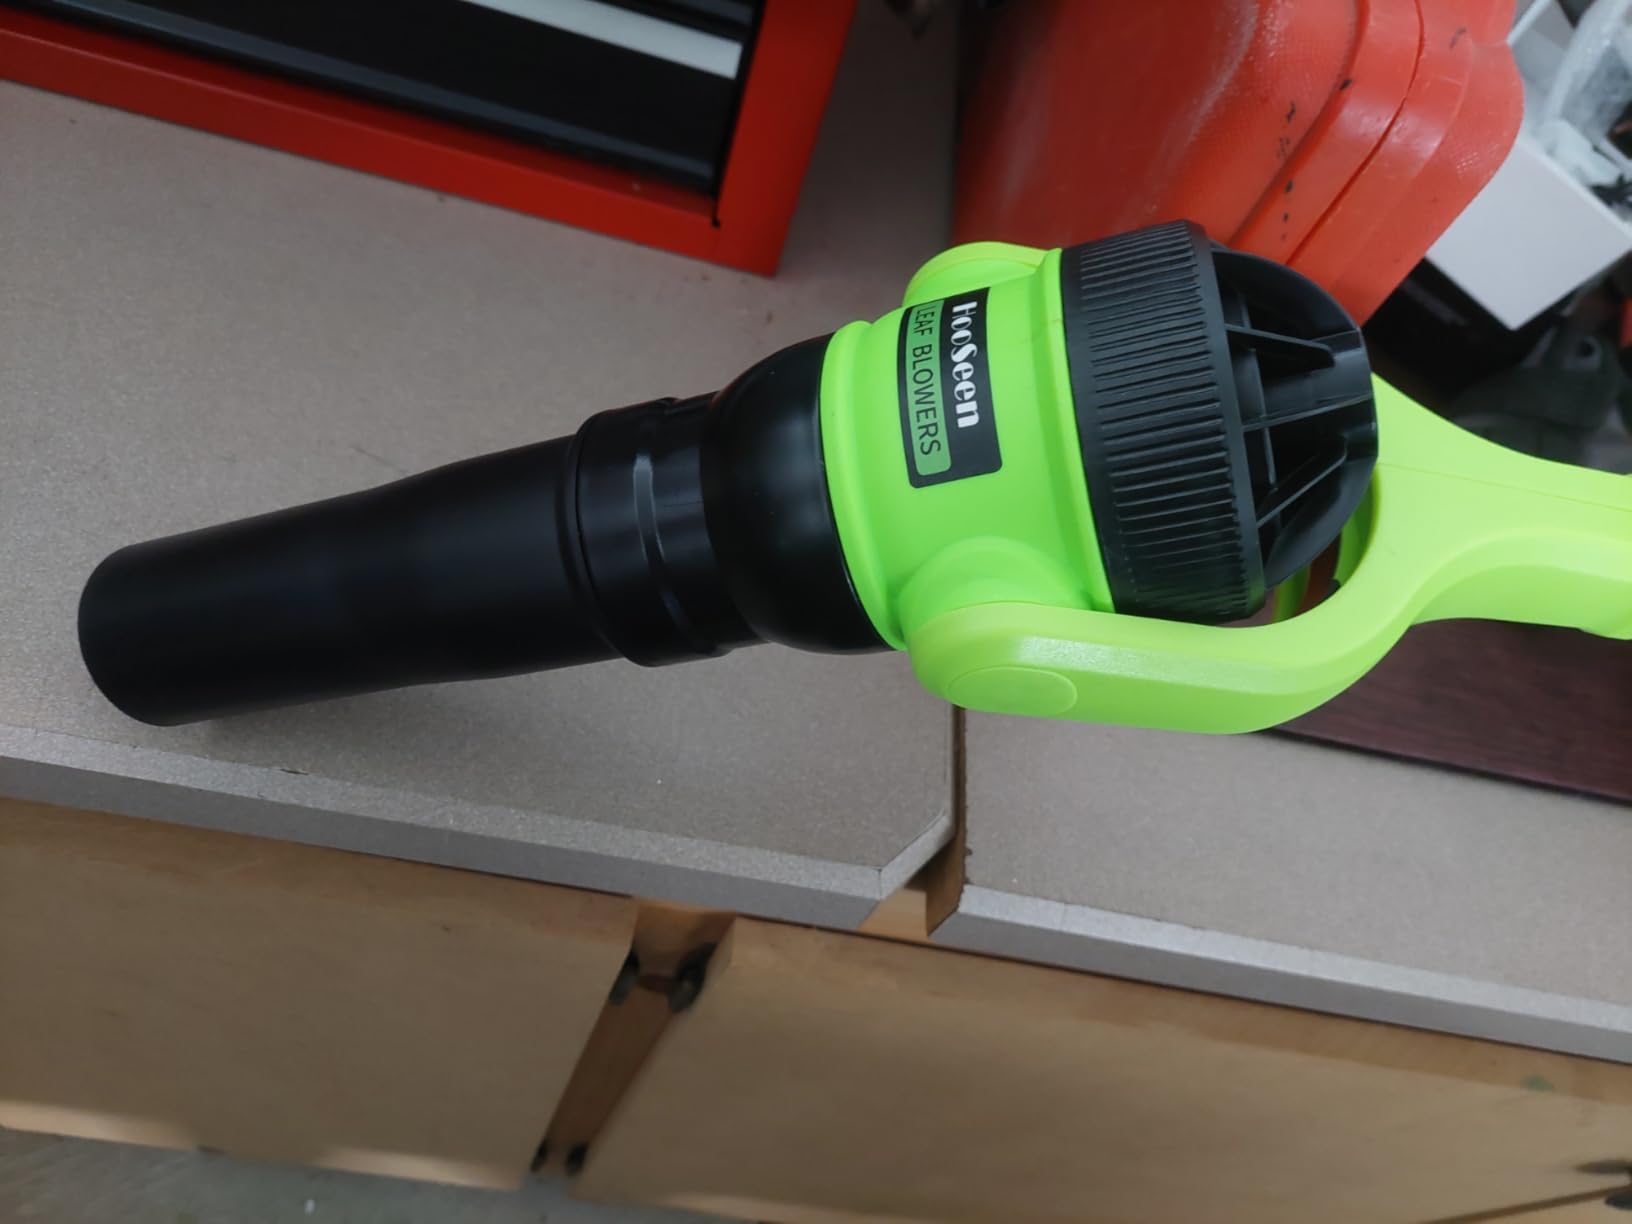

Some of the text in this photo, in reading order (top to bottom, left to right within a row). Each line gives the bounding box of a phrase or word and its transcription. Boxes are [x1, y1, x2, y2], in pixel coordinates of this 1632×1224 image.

[912, 305, 941, 456] LEAF BLOWERS
[951, 301, 980, 429] HooSeen
